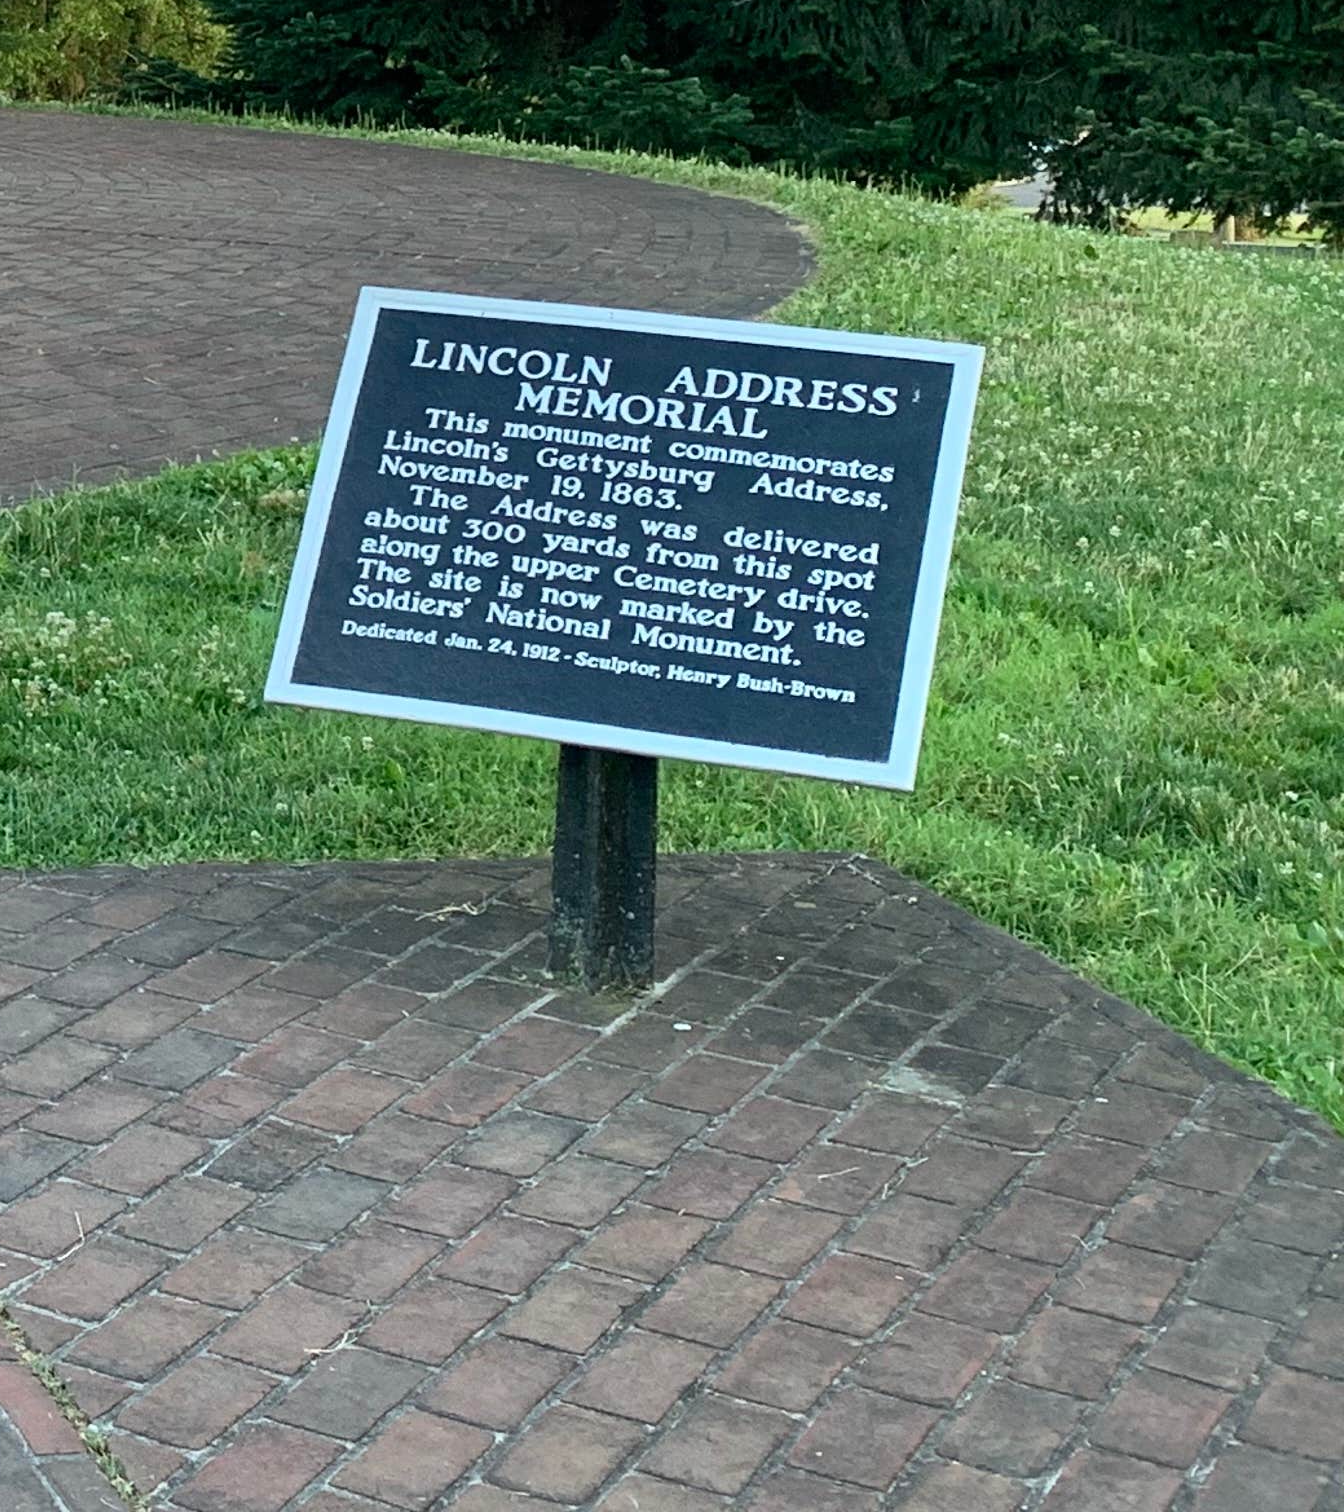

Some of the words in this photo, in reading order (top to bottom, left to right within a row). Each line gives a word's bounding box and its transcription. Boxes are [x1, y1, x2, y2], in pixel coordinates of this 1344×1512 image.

[410, 338, 613, 387] LINCOLN
[664, 366, 898, 416] ADDRESS
[514, 382, 768, 439] MEMORIAL
[377, 454, 529, 491] November
[600, 481, 683, 511] 1863.
[383, 429, 509, 463] Lincoln's
[536, 447, 716, 493] Gettysburg
[425, 407, 490, 434] This
[501, 421, 653, 454] monument
[668, 442, 895, 483] commemorates
[364, 507, 451, 535] about
[461, 518, 526, 544] 300
[542, 533, 631, 559] yards
[645, 542, 719, 571] from
[732, 553, 793, 580] this
[807, 568, 876, 591] spot
[409, 484, 469, 511] The
[490, 494, 618, 530] Address
[640, 519, 698, 541] was
[723, 525, 880, 565] delivered
[356, 557, 412, 584] The
[428, 568, 482, 593] site
[497, 574, 524, 599] is
[540, 586, 603, 610] now
[618, 599, 735, 629] marked
[752, 611, 795, 642] by
[813, 621, 865, 647] the
[360, 534, 441, 566] along
[452, 545, 499, 568] the
[511, 555, 600, 582] upper
[613, 564, 766, 608] Cemetery
[777, 588, 870, 619] drive.
[341, 620, 438, 645] Dedicated
[444, 632, 483, 651] Jan.
[521, 642, 561, 662] 1912
[666, 664, 732, 689] Henry
[736, 672, 856, 703] Bush-Brown
[348, 584, 472, 618] Soldiers'
[485, 601, 611, 640] National
[631, 622, 802, 666] Monument.
